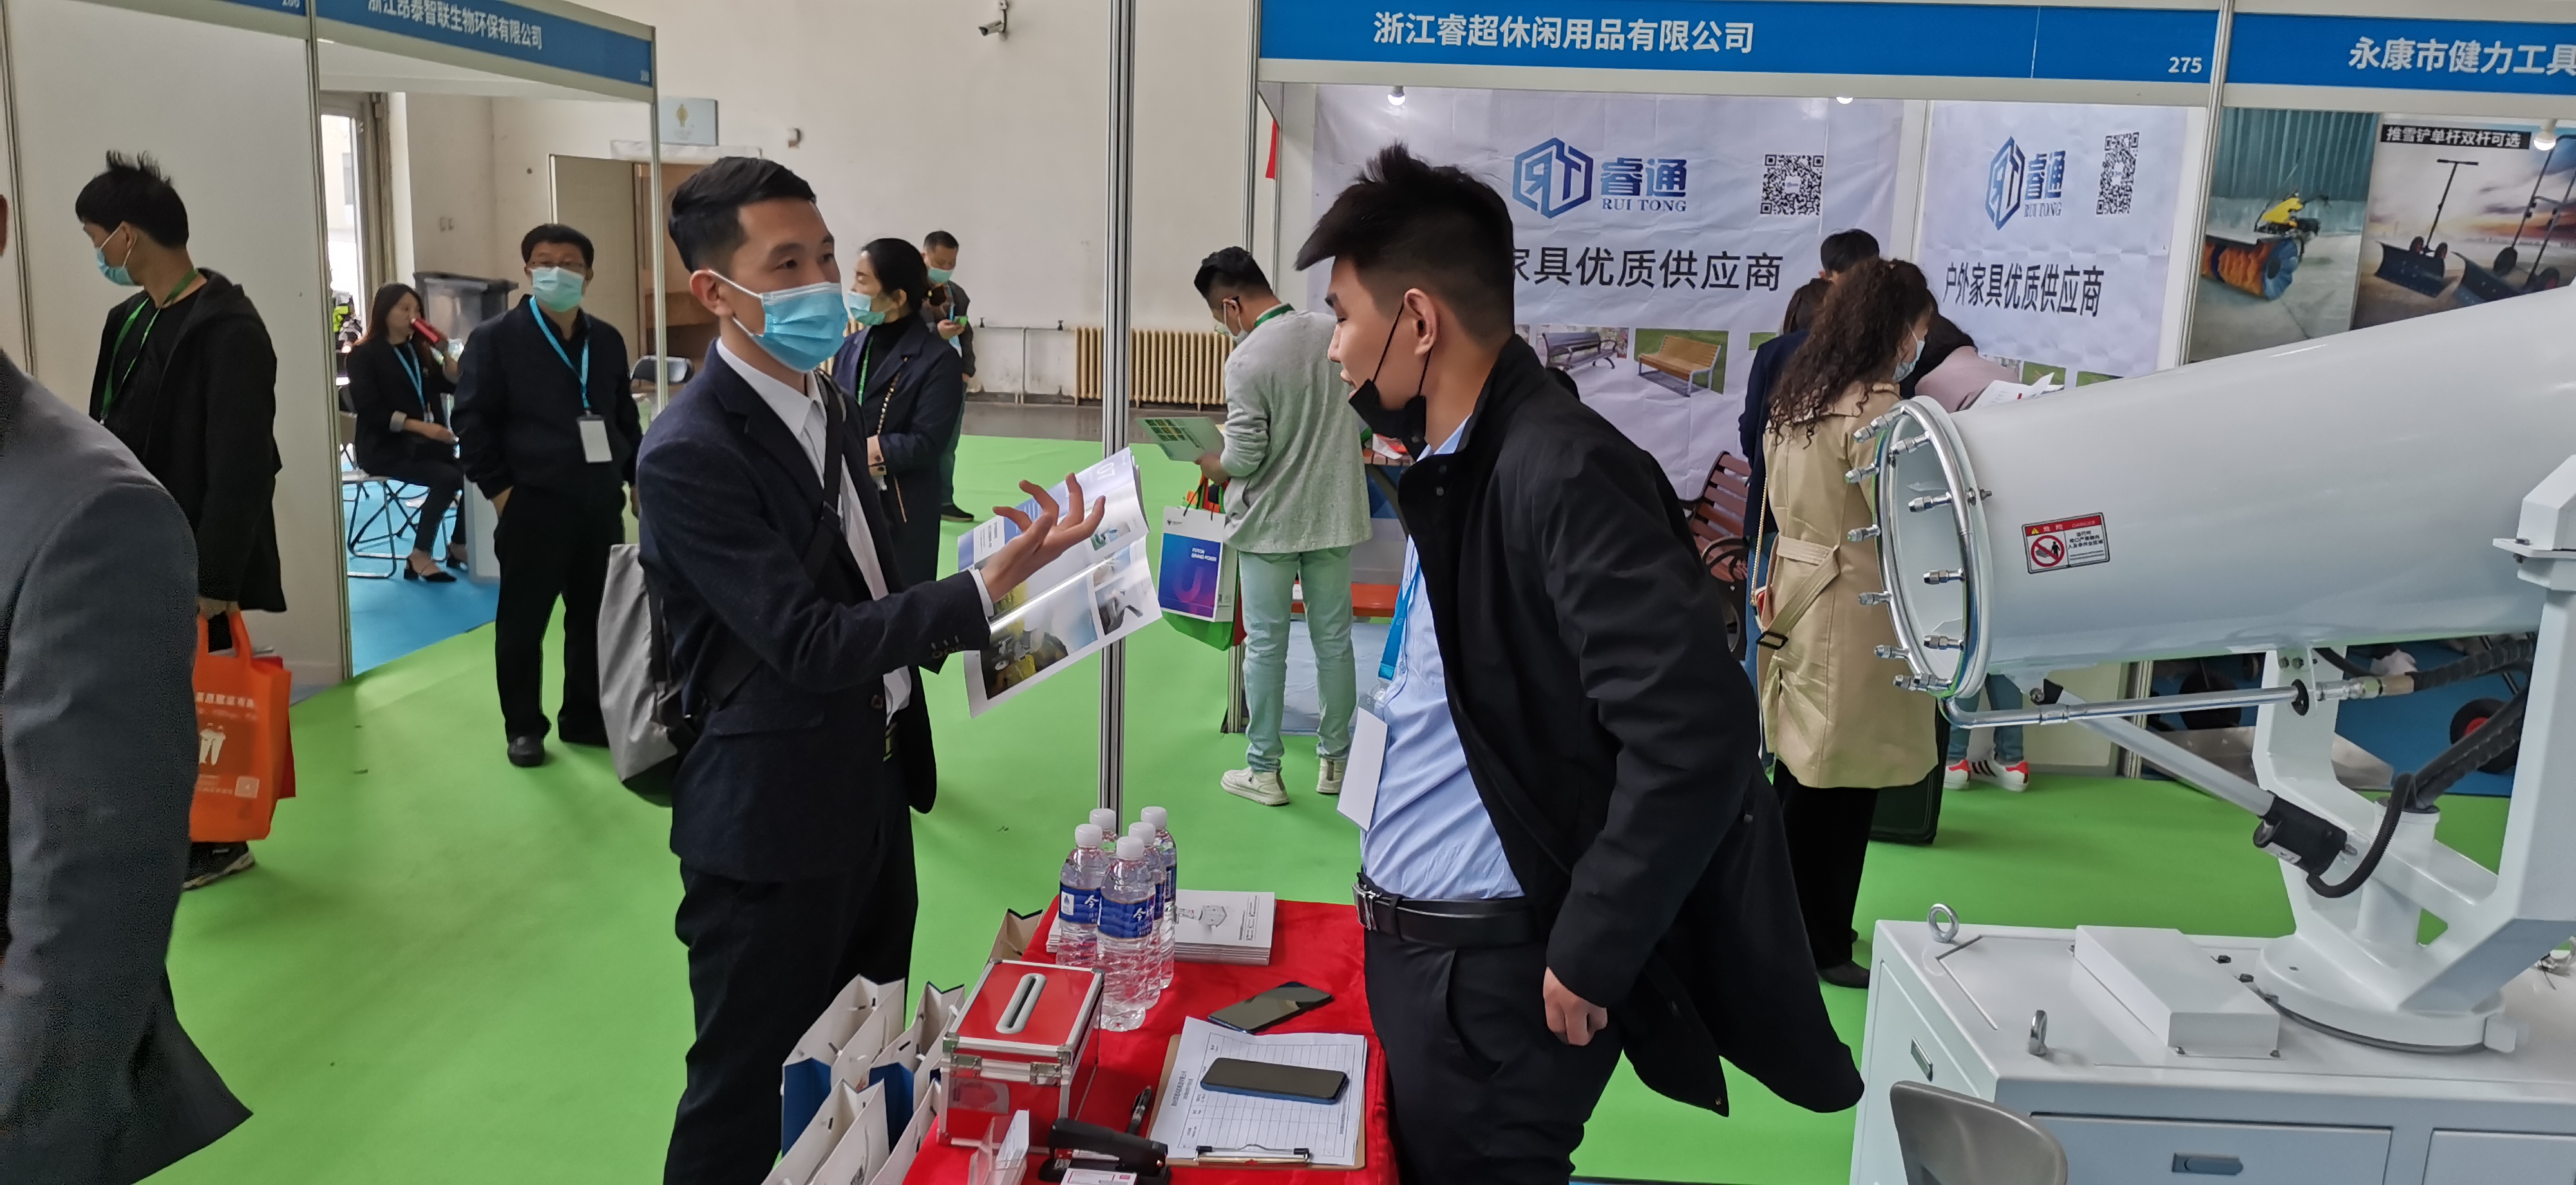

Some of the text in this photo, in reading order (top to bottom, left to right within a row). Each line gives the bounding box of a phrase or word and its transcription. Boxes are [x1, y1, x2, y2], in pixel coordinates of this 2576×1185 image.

[1373, 11, 1754, 53] 浙江睿超休闲用品有限公司
[2168, 55, 2203, 74] 275
[2348, 35, 2576, 76] 永康市健力工具
[2386, 126, 2522, 148] 推雪铲单杆双杆可选
[1600, 157, 1687, 198] 睿通
[2025, 149, 2066, 200] 睿通
[1602, 198, 1687, 213] RUI TONG
[2038, 202, 2062, 217] TONG
[1943, 261, 2105, 317] 户外家具优质供应商
